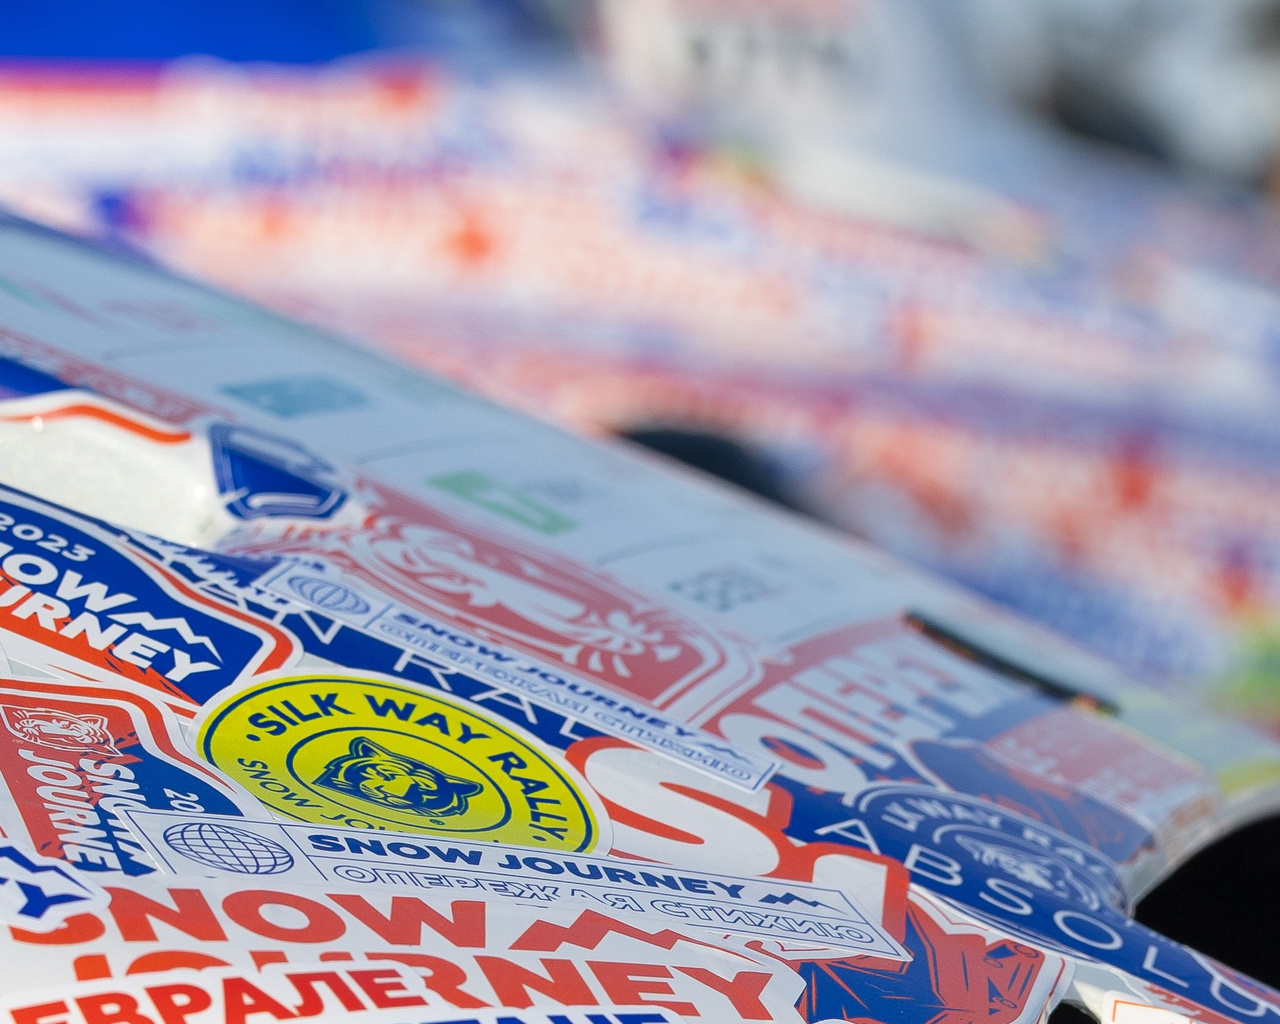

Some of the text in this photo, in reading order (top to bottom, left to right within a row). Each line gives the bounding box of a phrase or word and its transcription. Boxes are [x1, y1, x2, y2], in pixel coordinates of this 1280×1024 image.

[0, 543, 138, 612] OW
[394, 612, 699, 739] SNOW JOURNEY
[236, 757, 325, 810] SNOW
[249, 692, 571, 842] SILK WAY RALLY
[307, 833, 746, 900] SNOW JOURNEY
[650, 899, 875, 944] СТИХИЮ
